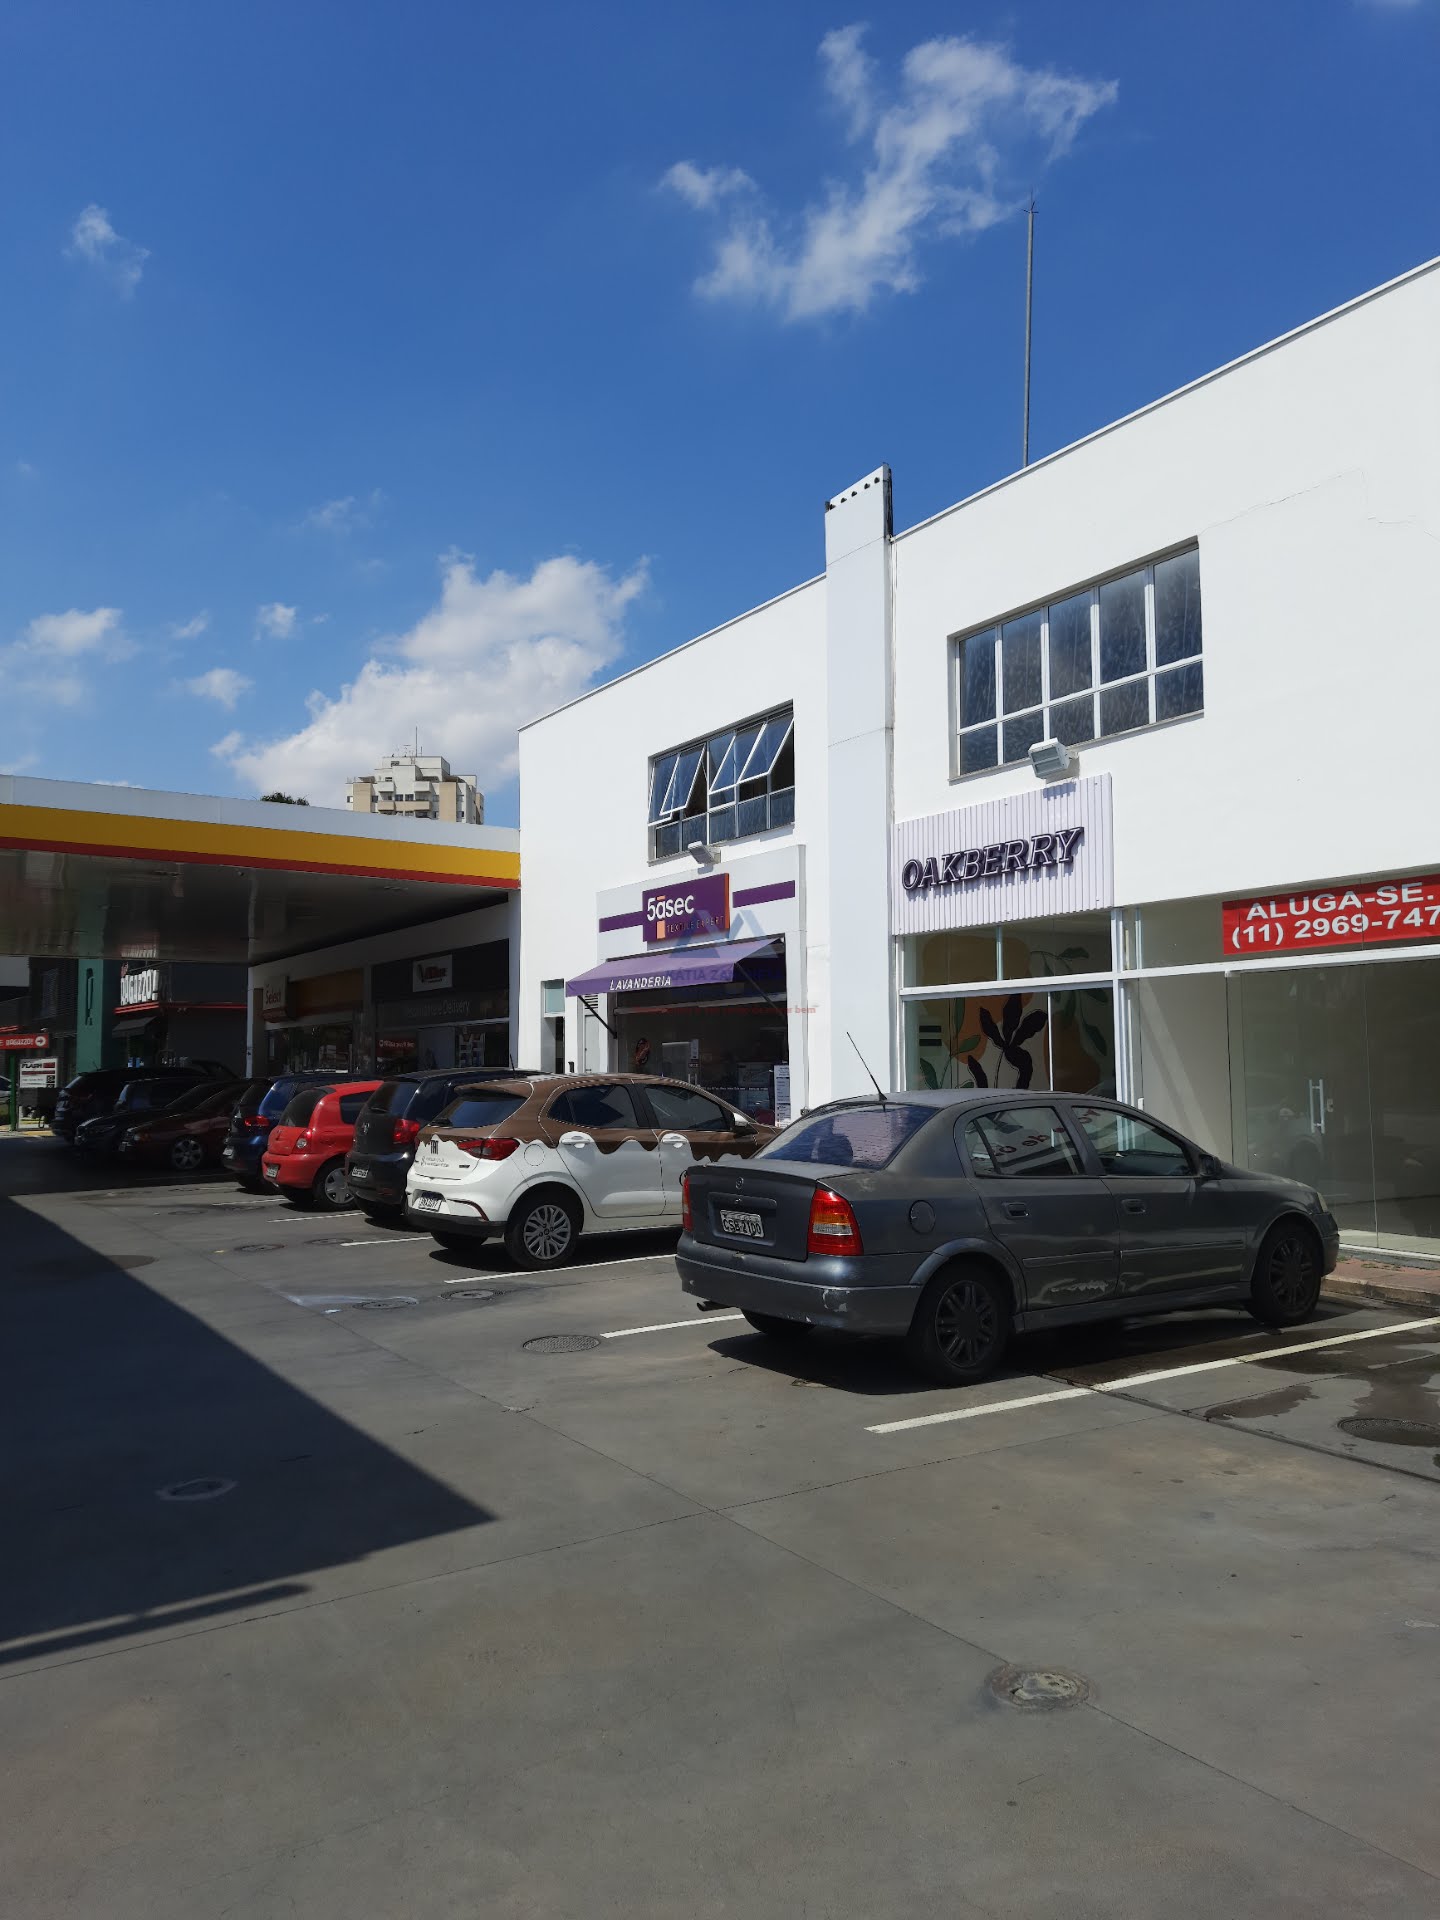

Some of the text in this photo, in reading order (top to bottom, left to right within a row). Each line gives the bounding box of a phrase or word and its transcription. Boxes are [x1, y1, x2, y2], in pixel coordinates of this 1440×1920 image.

[902, 827, 1085, 890] OAKBERRY
[1246, 881, 1434, 921] ALUGA-SE.
[1231, 923, 1284, 949] (11)
[609, 975, 672, 991] LAVANDERIA
